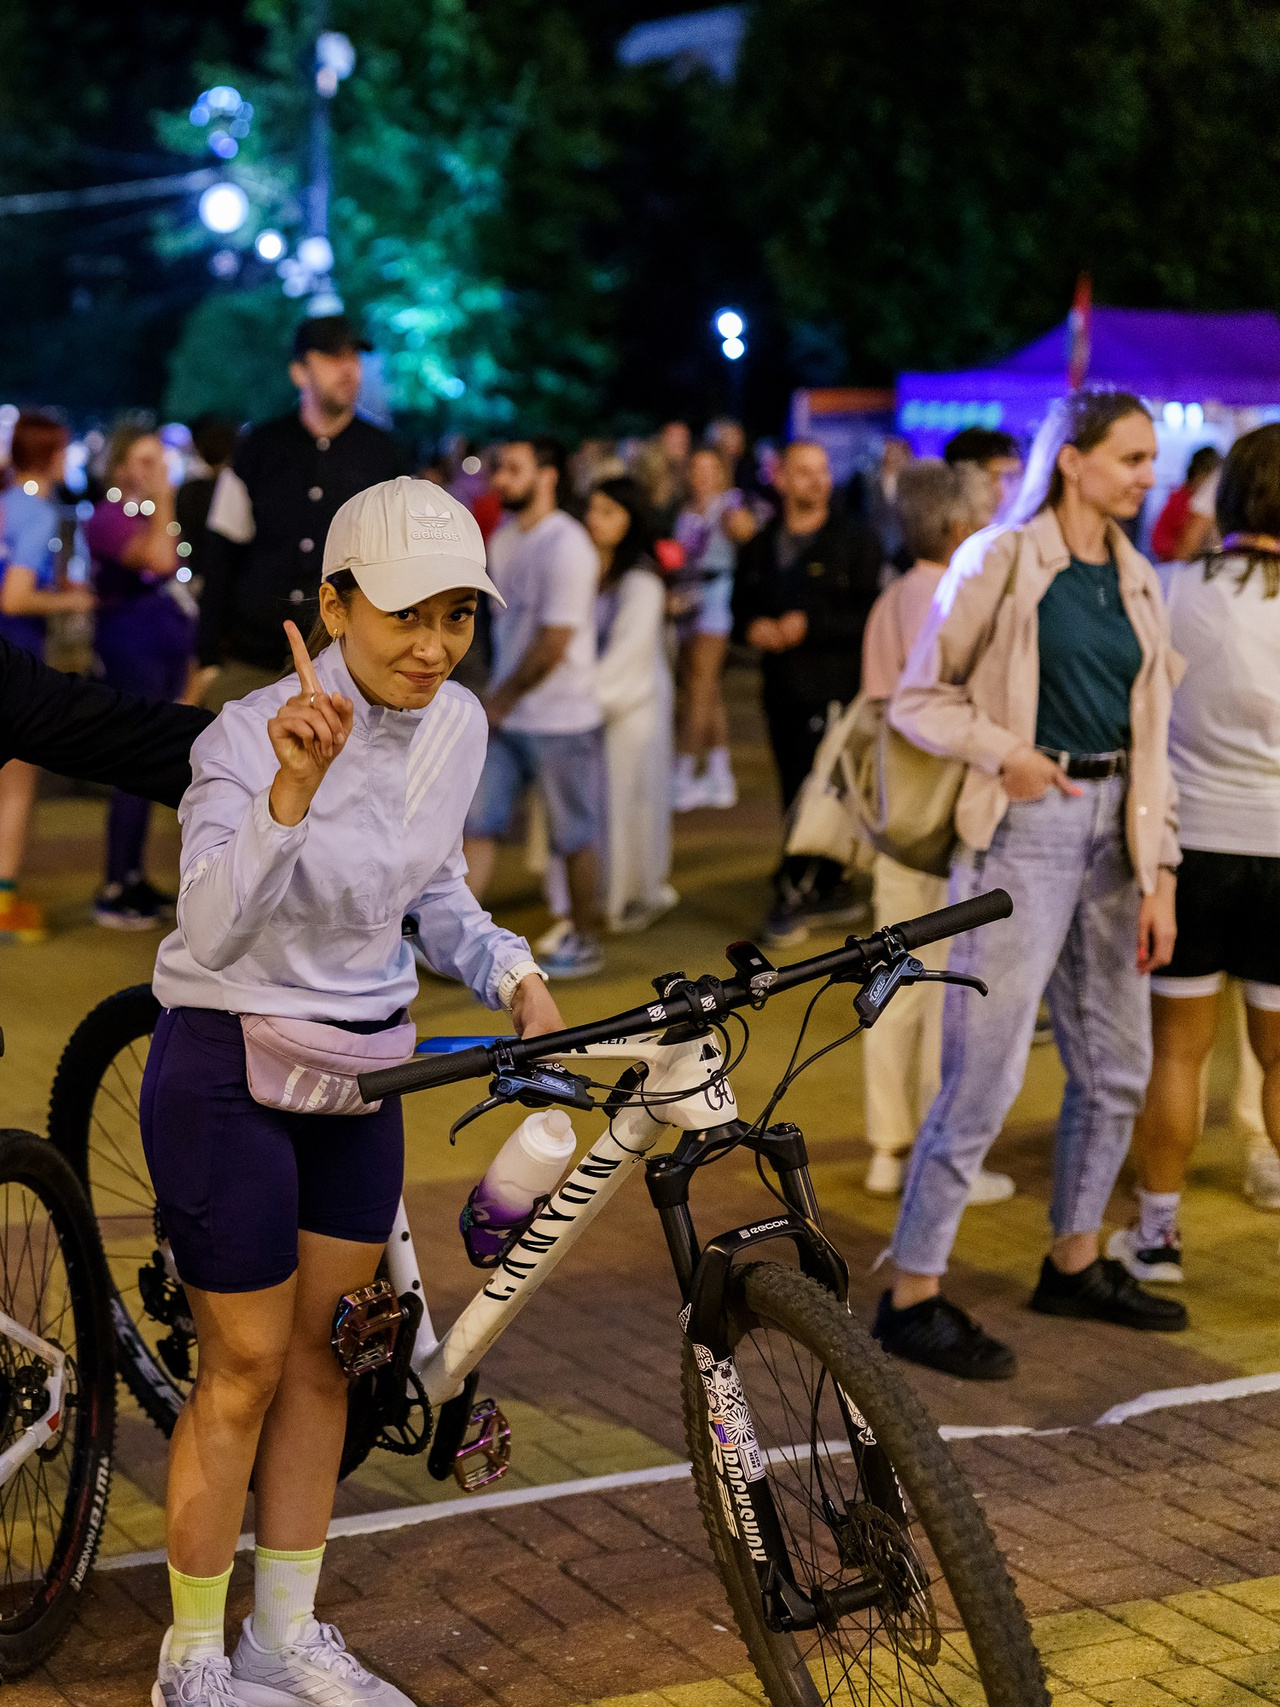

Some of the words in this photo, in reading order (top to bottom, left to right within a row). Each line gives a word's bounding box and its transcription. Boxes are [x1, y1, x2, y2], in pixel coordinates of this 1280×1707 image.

[411, 529, 460, 541] adidas
[482, 1151, 623, 1301] CANYON
[748, 1452, 757, 1469] HERE
[753, 1449, 761, 1467] CLICK
